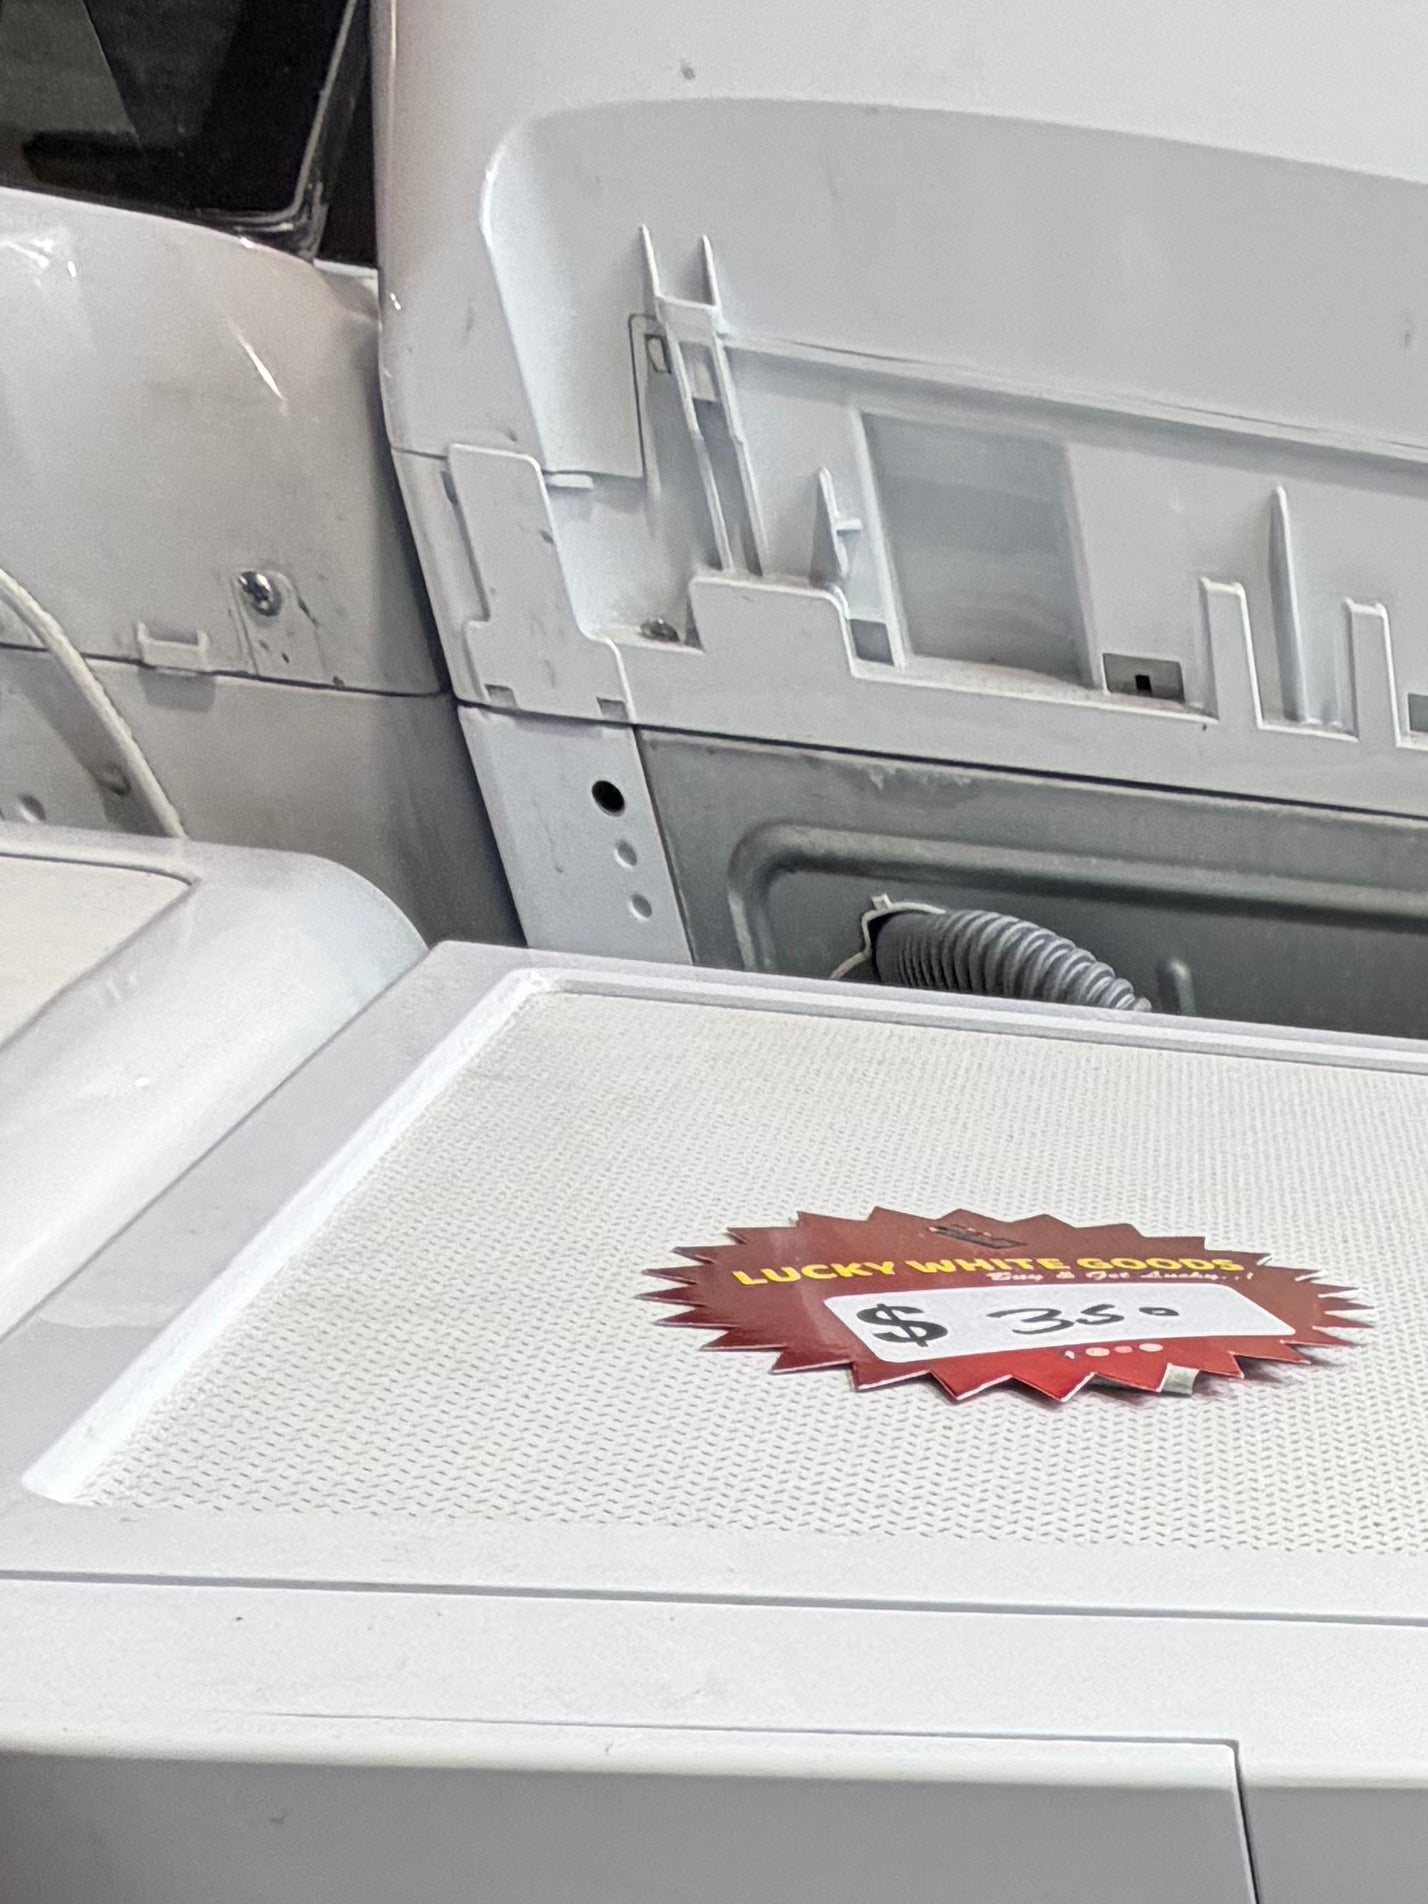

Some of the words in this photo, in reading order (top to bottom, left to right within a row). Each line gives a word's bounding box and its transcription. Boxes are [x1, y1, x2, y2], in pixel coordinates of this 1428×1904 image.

[732, 1261, 896, 1285] LUCKY
[905, 1257, 1072, 1274] WHITE
[1077, 1257, 1245, 1272] GOODS
[857, 1303, 948, 1347] $
[986, 1303, 1180, 1335] 350
